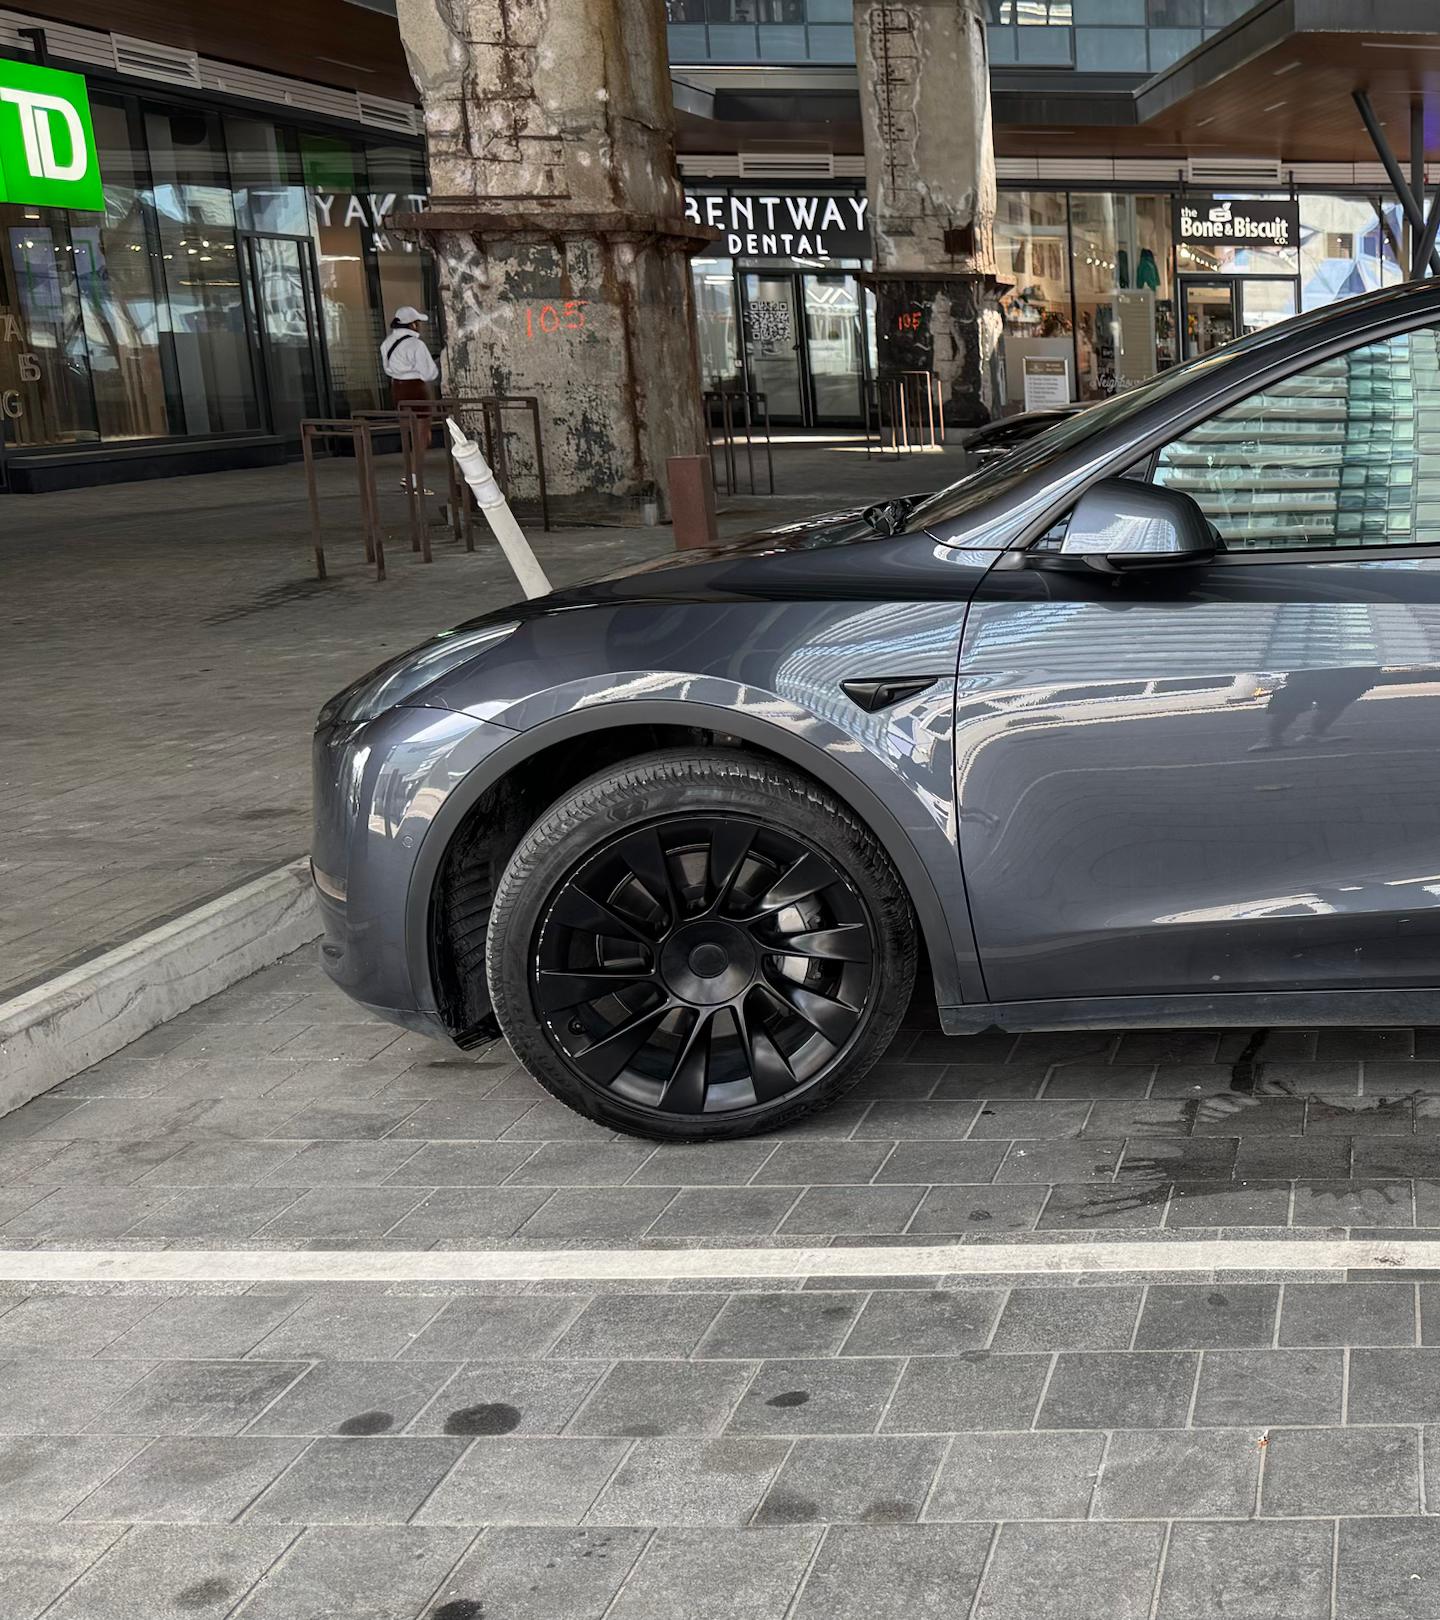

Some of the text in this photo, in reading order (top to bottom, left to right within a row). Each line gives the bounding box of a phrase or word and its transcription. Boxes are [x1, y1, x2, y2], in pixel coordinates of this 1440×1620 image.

[0, 87, 88, 182] TD
[1181, 206, 1198, 218] the
[1180, 216, 1288, 238] Bone & Biscuit
[728, 234, 829, 255] DENTAL
[1273, 236, 1288, 245] co.
[525, 300, 590, 338] 105
[898, 311, 921, 331] 105
